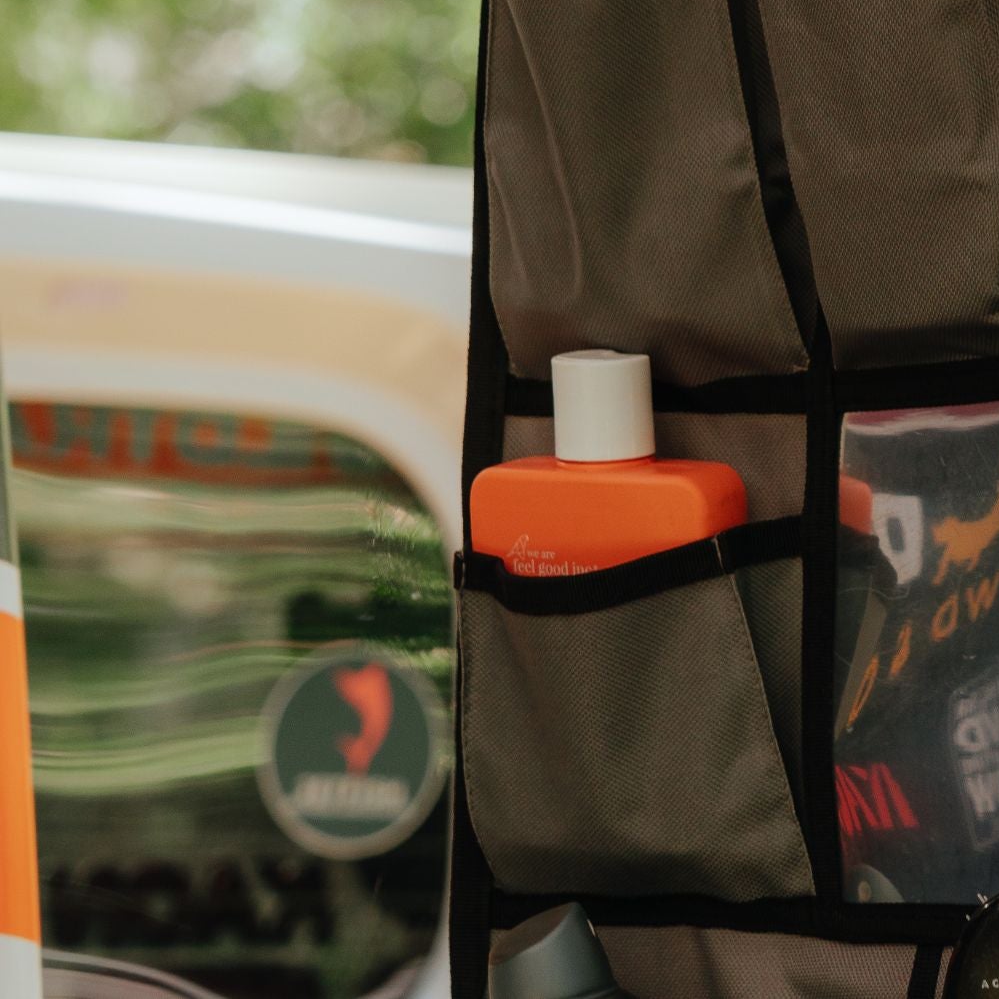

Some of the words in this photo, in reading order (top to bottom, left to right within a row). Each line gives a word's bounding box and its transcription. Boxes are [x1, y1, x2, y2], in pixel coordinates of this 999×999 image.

[527, 550, 539, 558] we
[540, 551, 556, 559] are
[513, 558, 535, 573] feel
[538, 561, 569, 577] good
